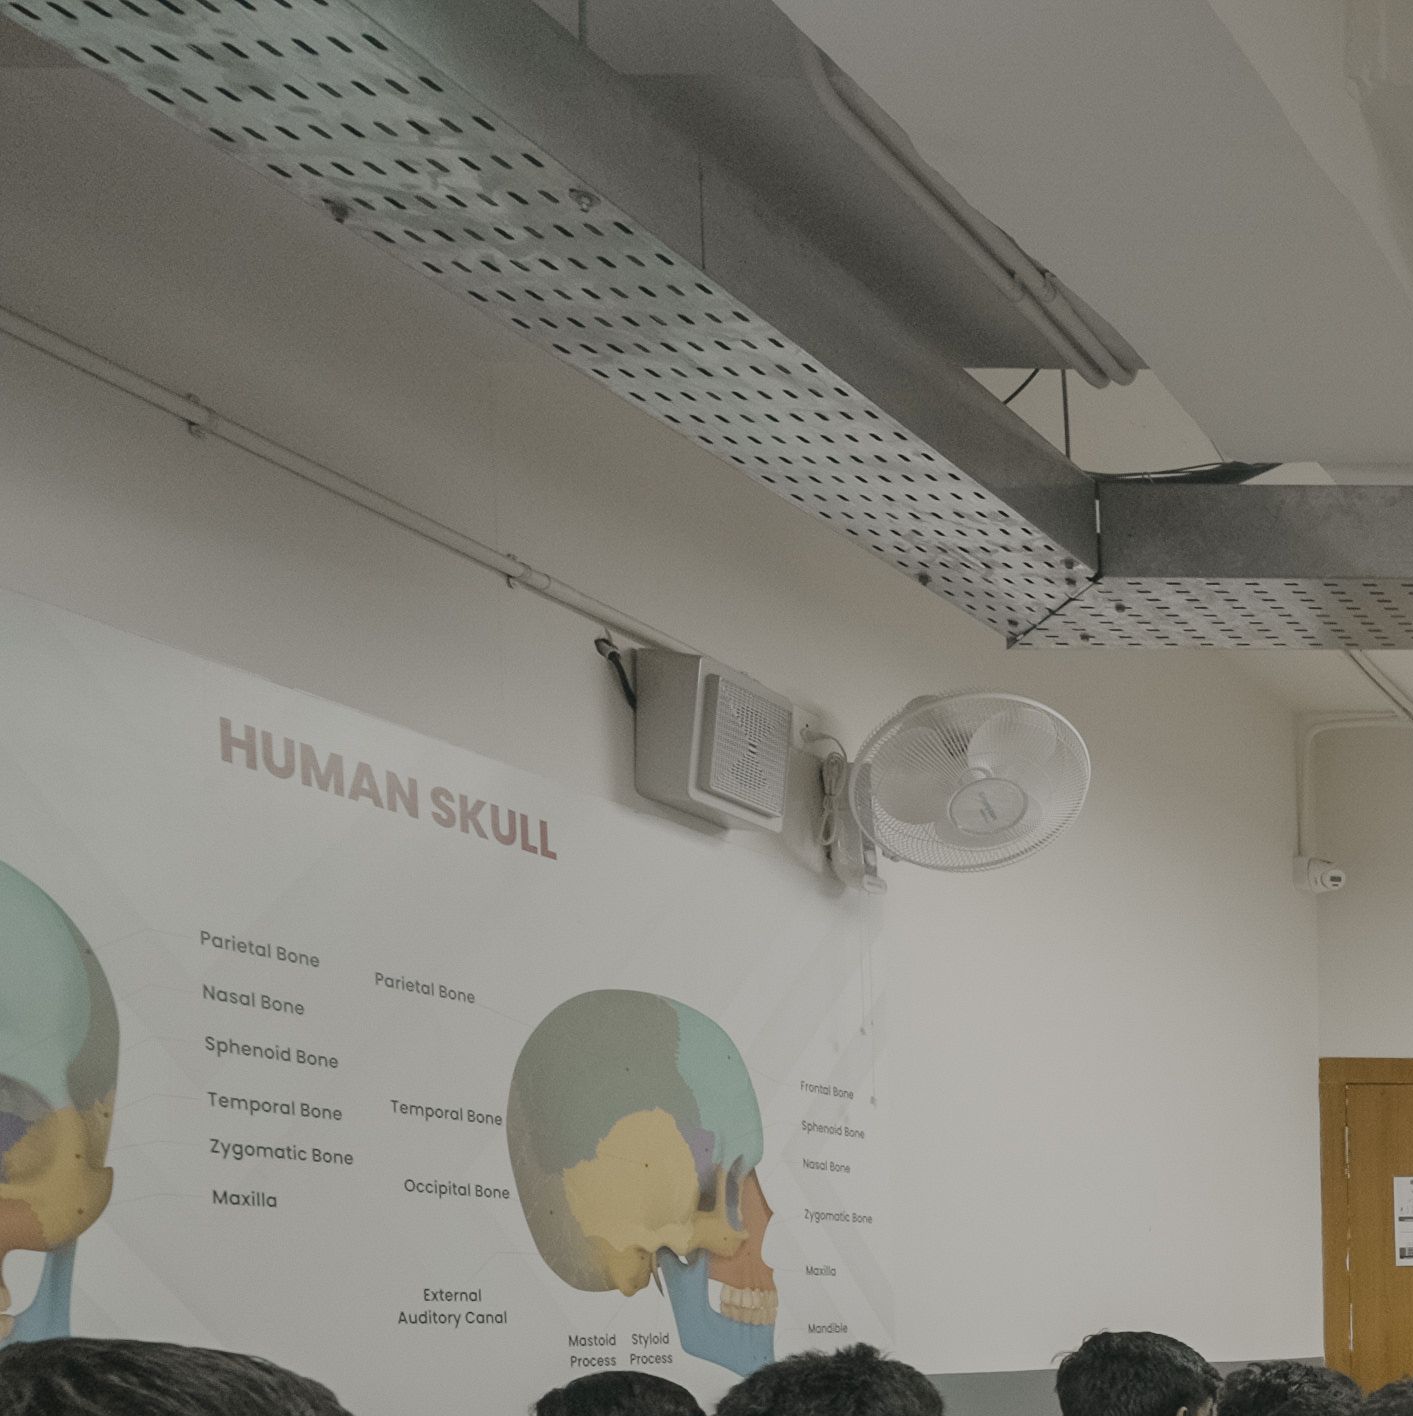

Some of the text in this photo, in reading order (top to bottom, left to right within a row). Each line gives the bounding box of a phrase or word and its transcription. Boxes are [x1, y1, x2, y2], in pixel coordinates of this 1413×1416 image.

[219, 716, 557, 860] HUMAN SKULL
[200, 931, 320, 968] Parietal Bone
[375, 972, 475, 1004] Parietal Bone
[202, 984, 304, 1016] Nasal Bone
[205, 1036, 338, 1069] Sphenoid Bone
[801, 1081, 854, 1100] Frontal Bone
[208, 1091, 342, 1121] Temporal Bone
[390, 1100, 502, 1126] Temporal Bone
[802, 1121, 865, 1139] Sphenoid Bone
[209, 1139, 353, 1165] Zygomatic Bone
[803, 1159, 850, 1173] Nasal Bone
[404, 1179, 510, 1199] Occipital Bone
[212, 1190, 277, 1207] Maxilla
[804, 1209, 872, 1224] Zygomatic Bone
[806, 1266, 836, 1276] Maxilla
[423, 1289, 481, 1302] External
[398, 1311, 507, 1328] Auditory Canal
[808, 1324, 847, 1334] Mandible
[568, 1334, 616, 1347] Mastoid
[631, 1332, 669, 1348] Styloid
[571, 1355, 616, 1368] Process
[630, 1352, 673, 1366] Process
